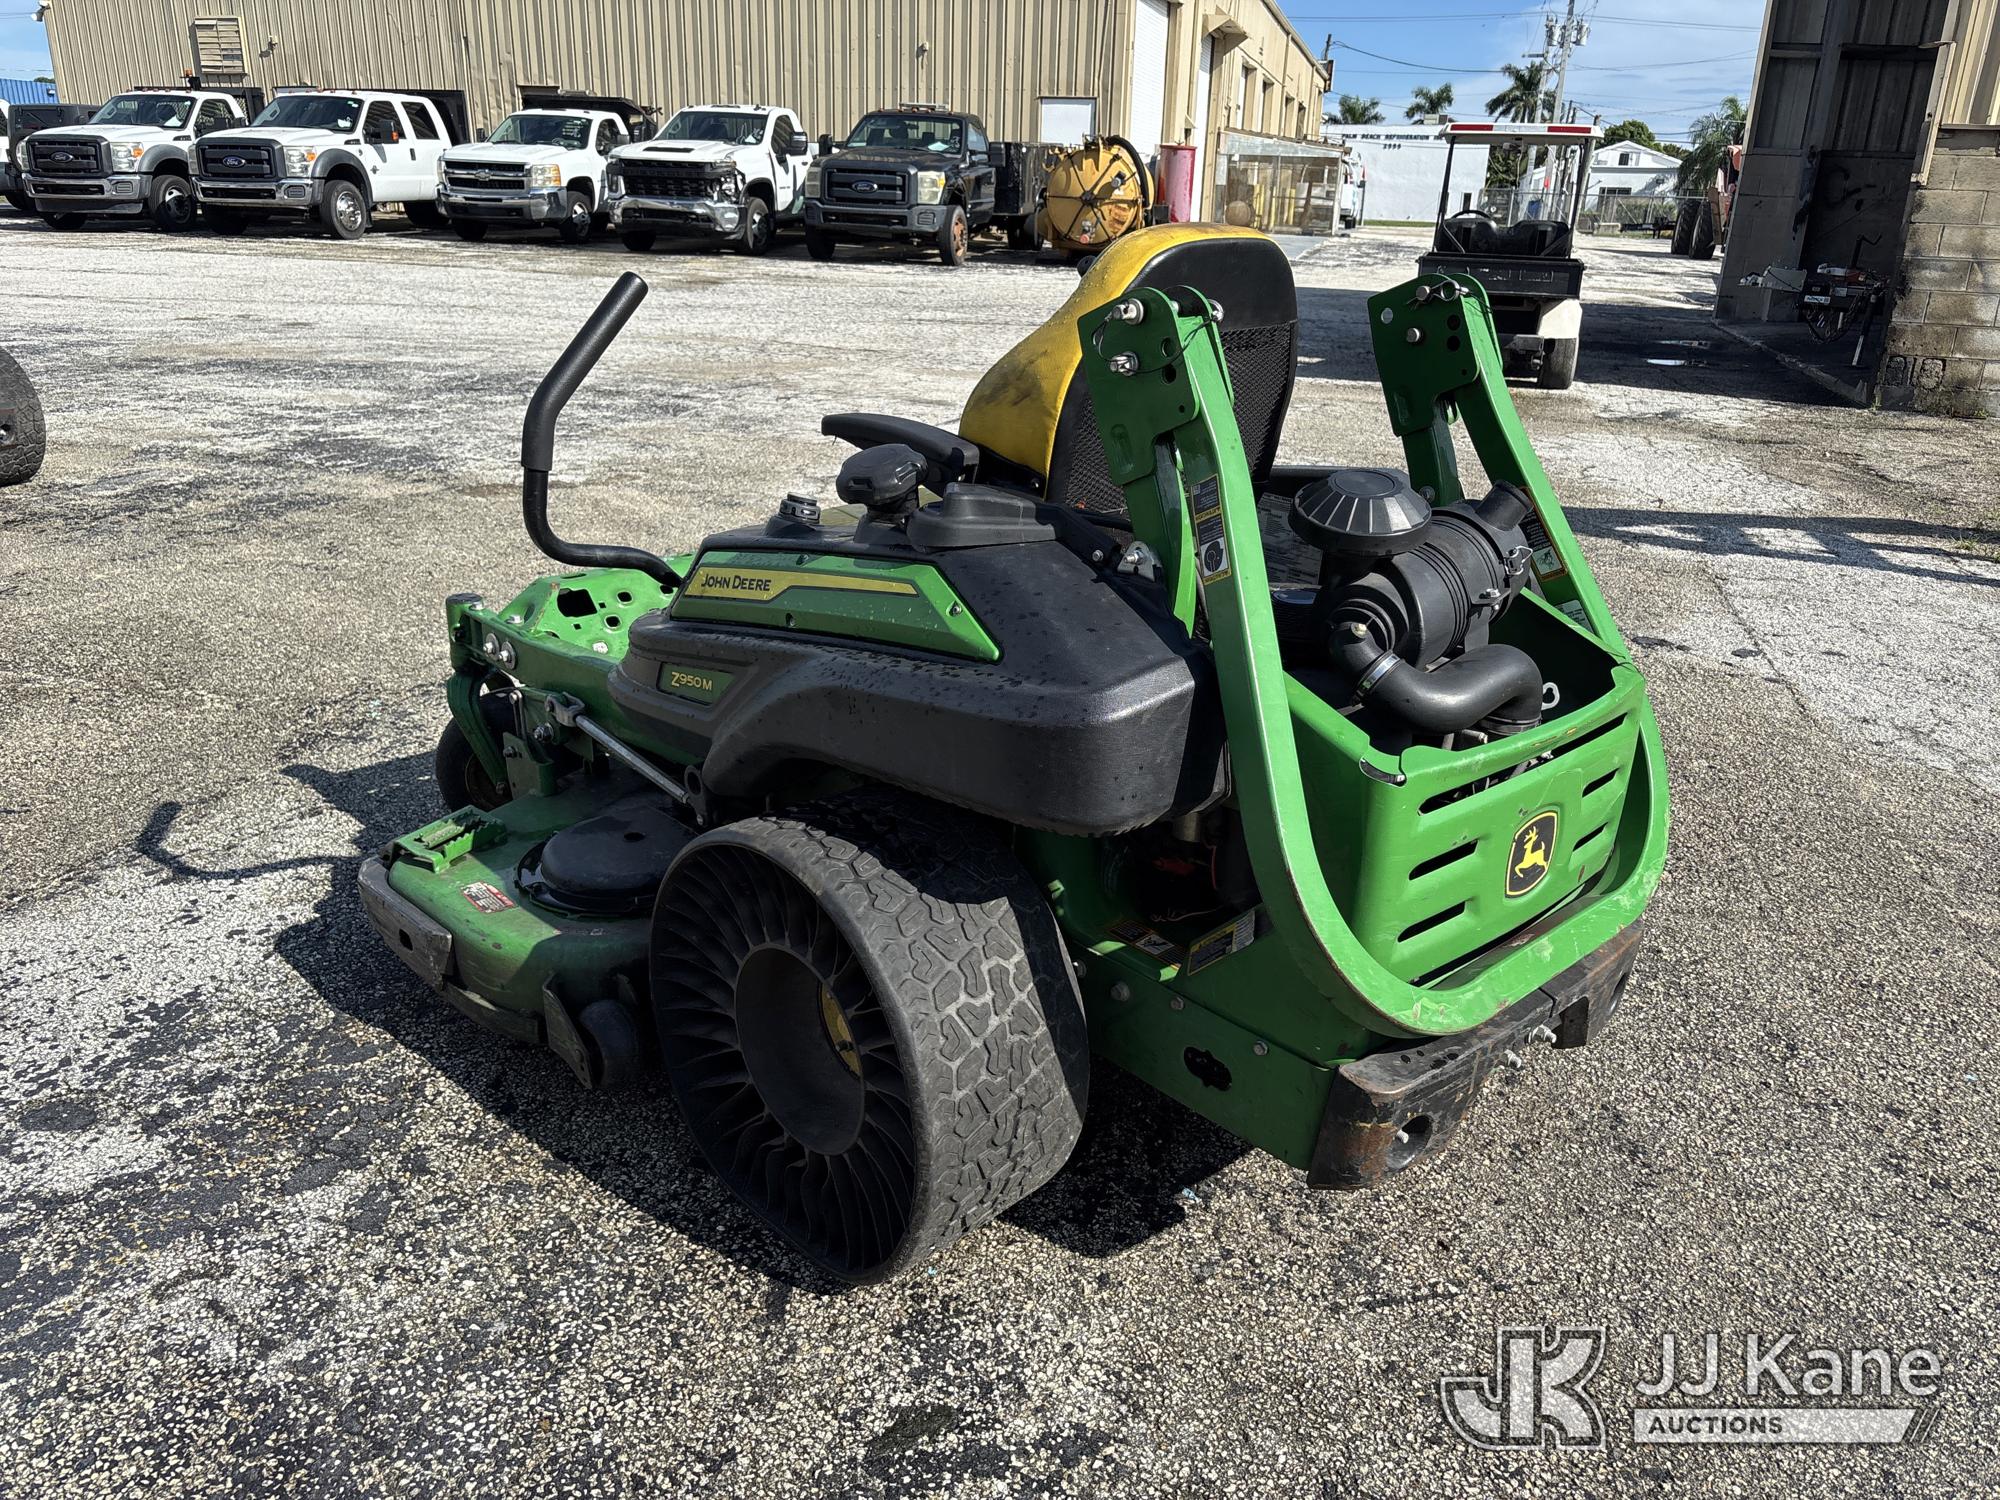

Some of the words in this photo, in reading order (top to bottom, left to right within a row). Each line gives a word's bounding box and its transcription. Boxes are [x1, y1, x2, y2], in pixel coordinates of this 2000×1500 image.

[701, 573, 731, 589] JOHN
[731, 575, 772, 591] DEERE
[671, 671, 713, 691] Z950M
